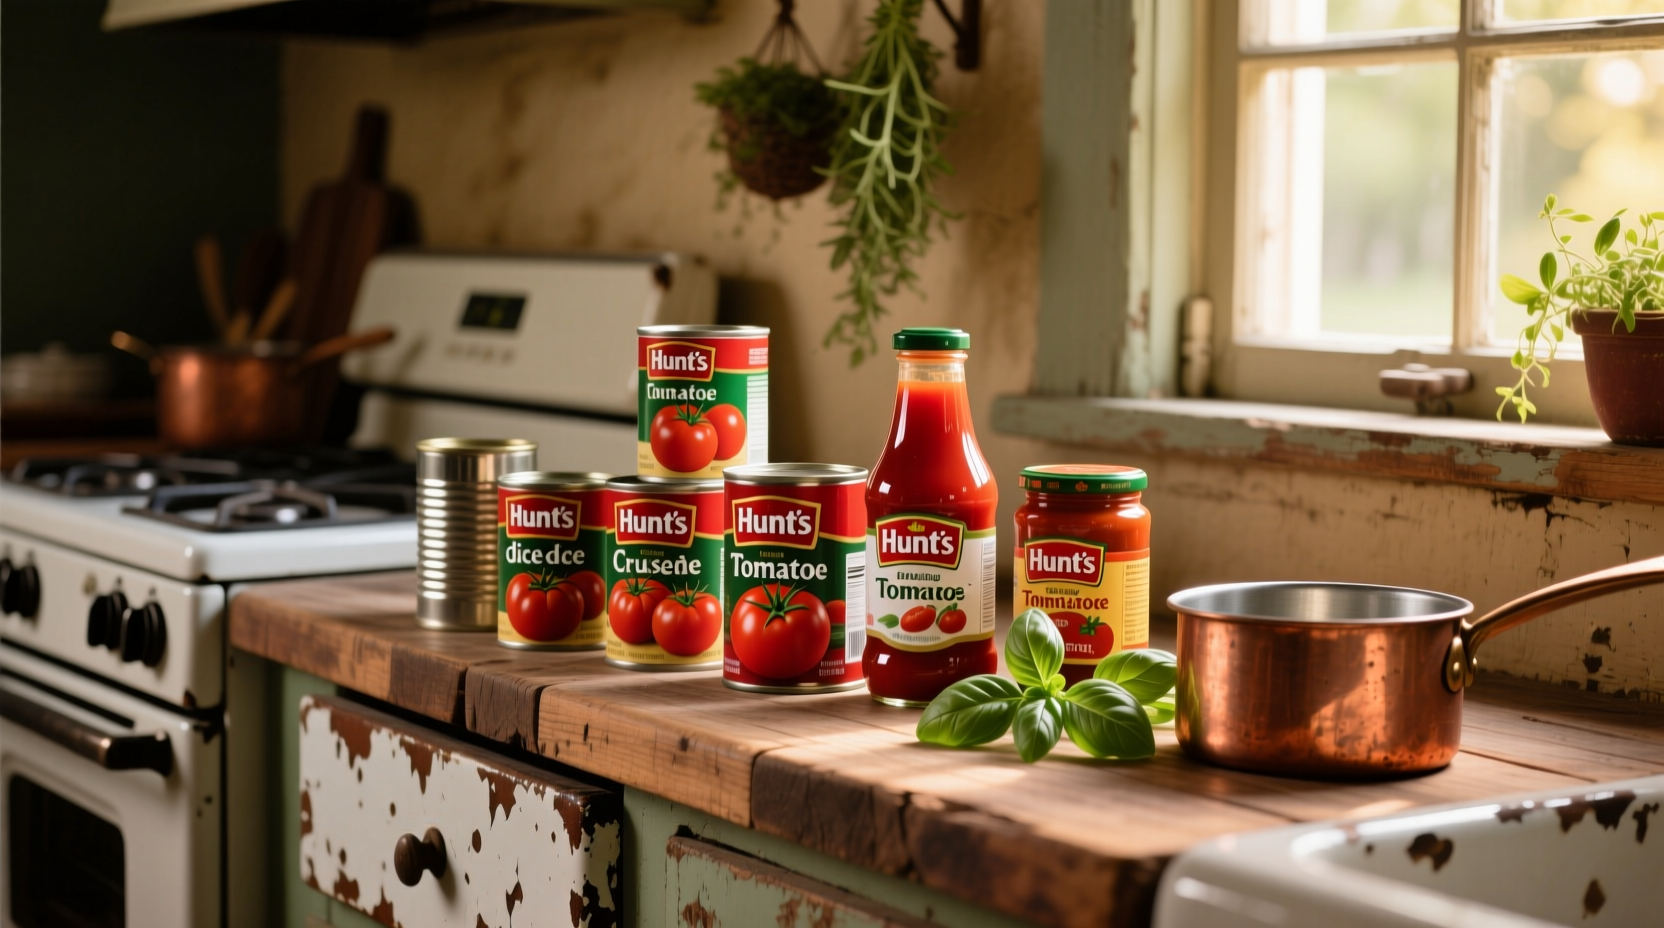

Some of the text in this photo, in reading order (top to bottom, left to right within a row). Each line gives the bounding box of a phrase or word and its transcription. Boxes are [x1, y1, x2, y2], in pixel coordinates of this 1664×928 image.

[651, 349, 708, 371] Hunt's
[510, 503, 574, 528] Hunt's
[619, 508, 688, 535] Hunt's
[738, 507, 812, 535] Hunt's
[882, 528, 954, 555] Hunt's
[730, 552, 828, 580] Tomatoe
[1029, 548, 1096, 574] Hunt's
